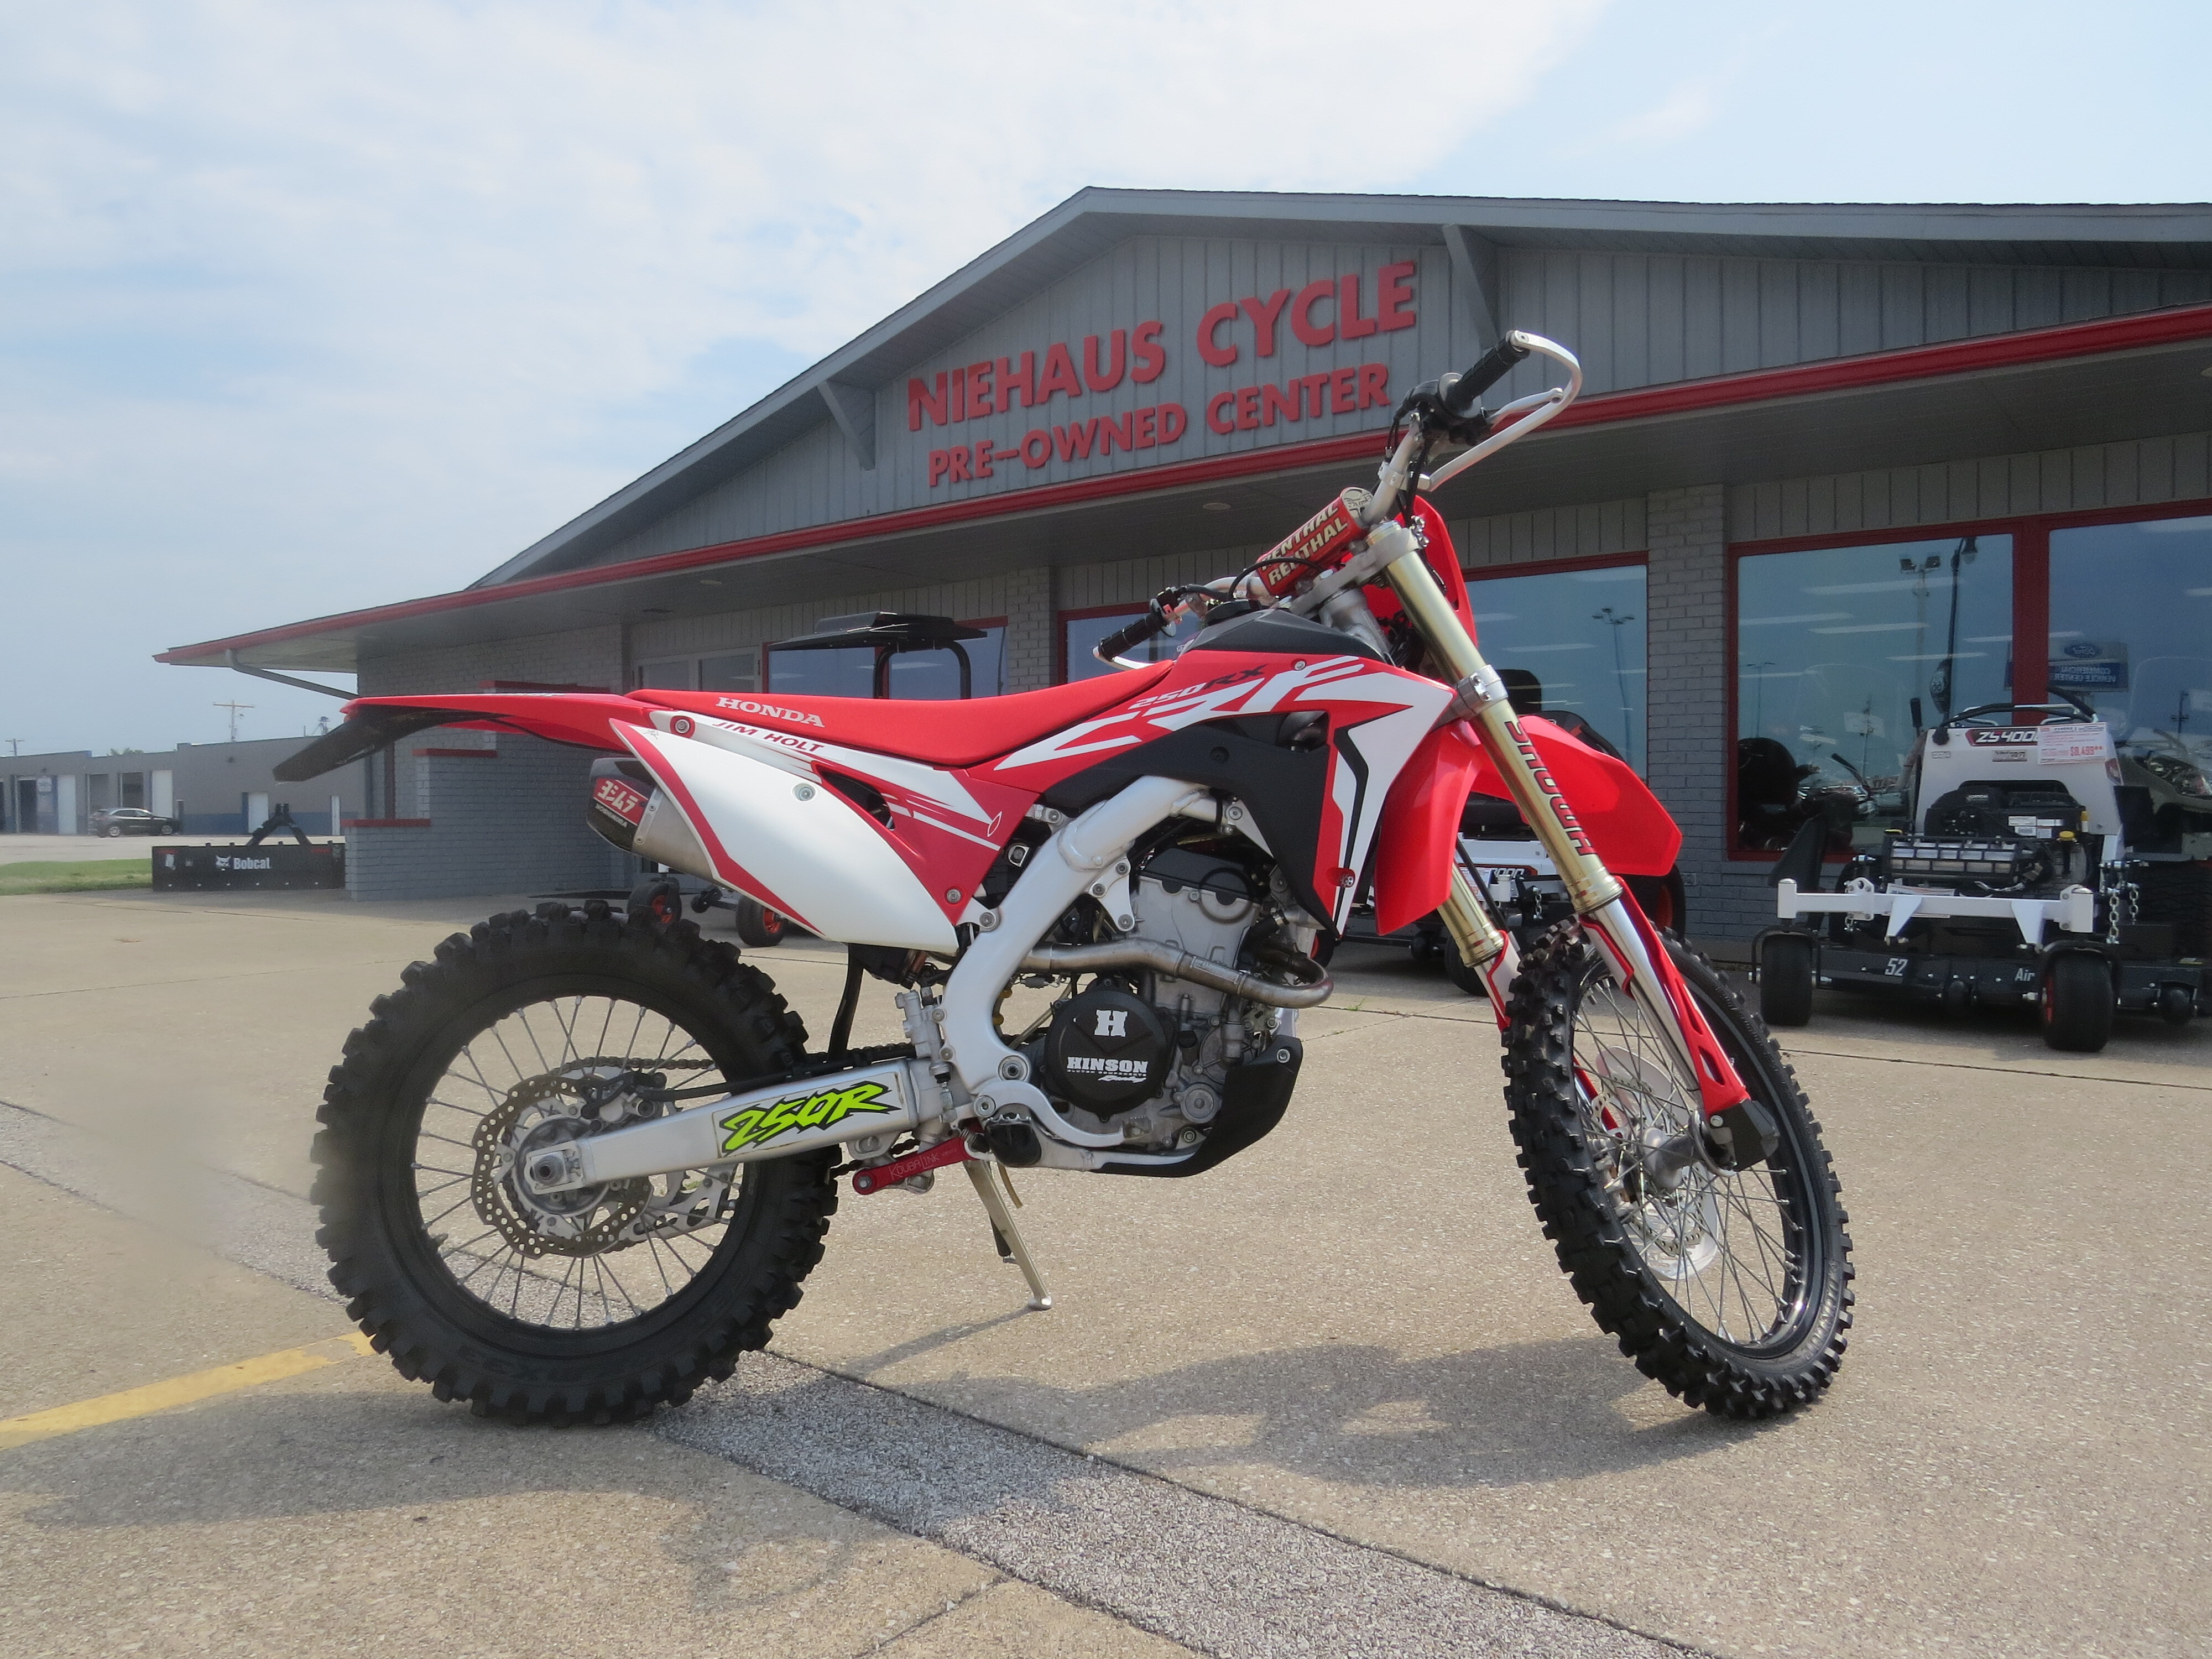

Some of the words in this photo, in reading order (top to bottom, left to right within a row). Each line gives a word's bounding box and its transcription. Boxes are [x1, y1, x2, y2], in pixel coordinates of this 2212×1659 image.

[907, 320, 1165, 431] NIEHAUS
[1197, 261, 1416, 367] CYCLE
[928, 403, 1188, 487] PRE-OWNED
[1207, 363, 1390, 434] CENTER
[716, 697, 825, 728] HONDA
[712, 722, 758, 735] JIM
[763, 733, 825, 752] HOLT
[1975, 730, 2038, 743] ZS400
[597, 780, 639, 813] ヨシムラ
[233, 857, 271, 870] Bobcat
[1885, 958, 1908, 977] 52
[1094, 1009, 1128, 1037] H
[1067, 1056, 1149, 1073] HINSON
[721, 1081, 897, 1155] 250R
